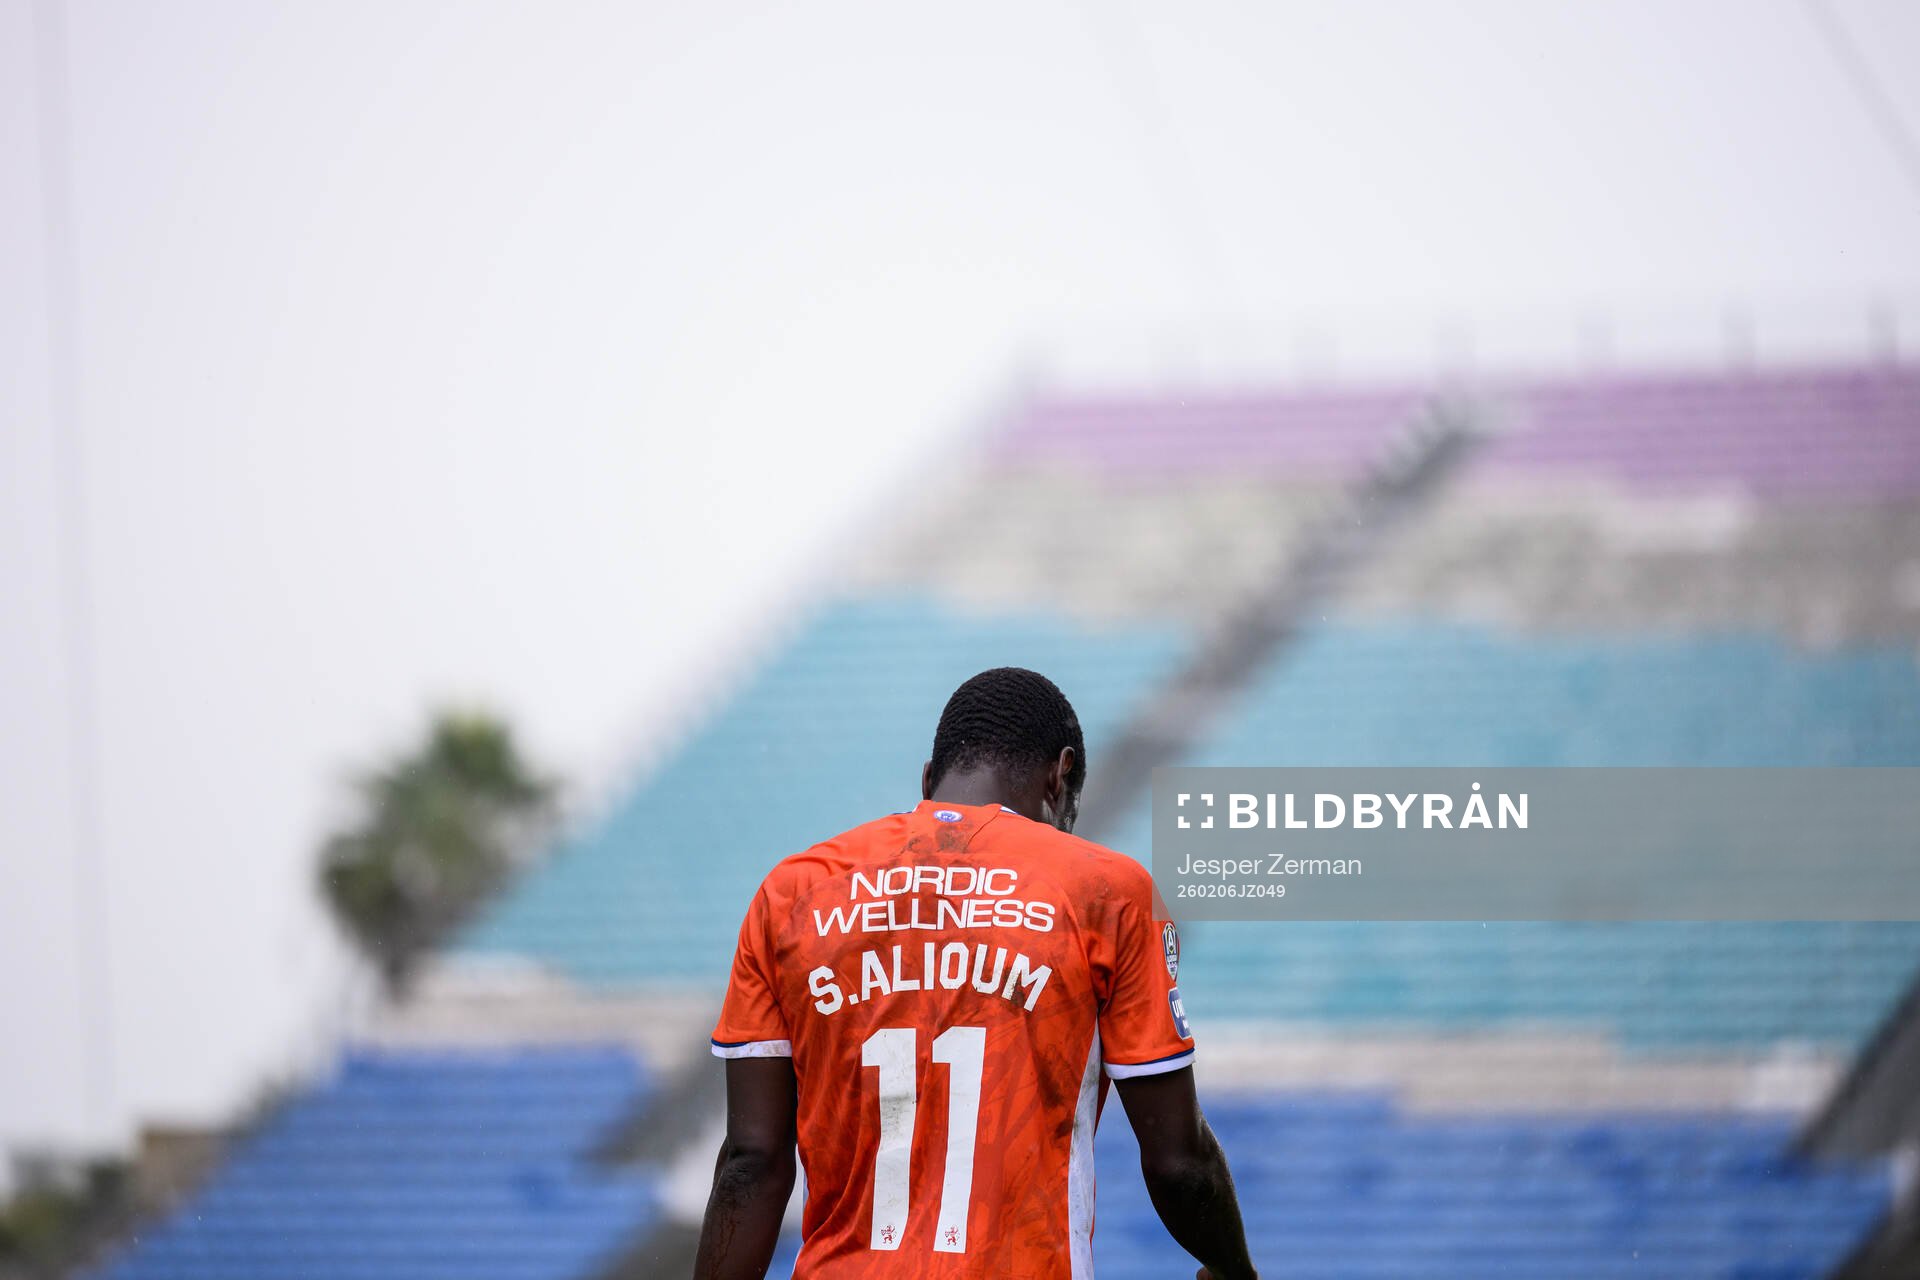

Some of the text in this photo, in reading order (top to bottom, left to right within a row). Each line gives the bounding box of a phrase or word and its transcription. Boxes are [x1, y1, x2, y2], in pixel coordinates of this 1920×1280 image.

[850, 866, 1017, 899] NORDIC
[813, 899, 1055, 936] WELLNESS
[808, 941, 1053, 1016] S.ALIOUM
[861, 1026, 987, 1254] 11
